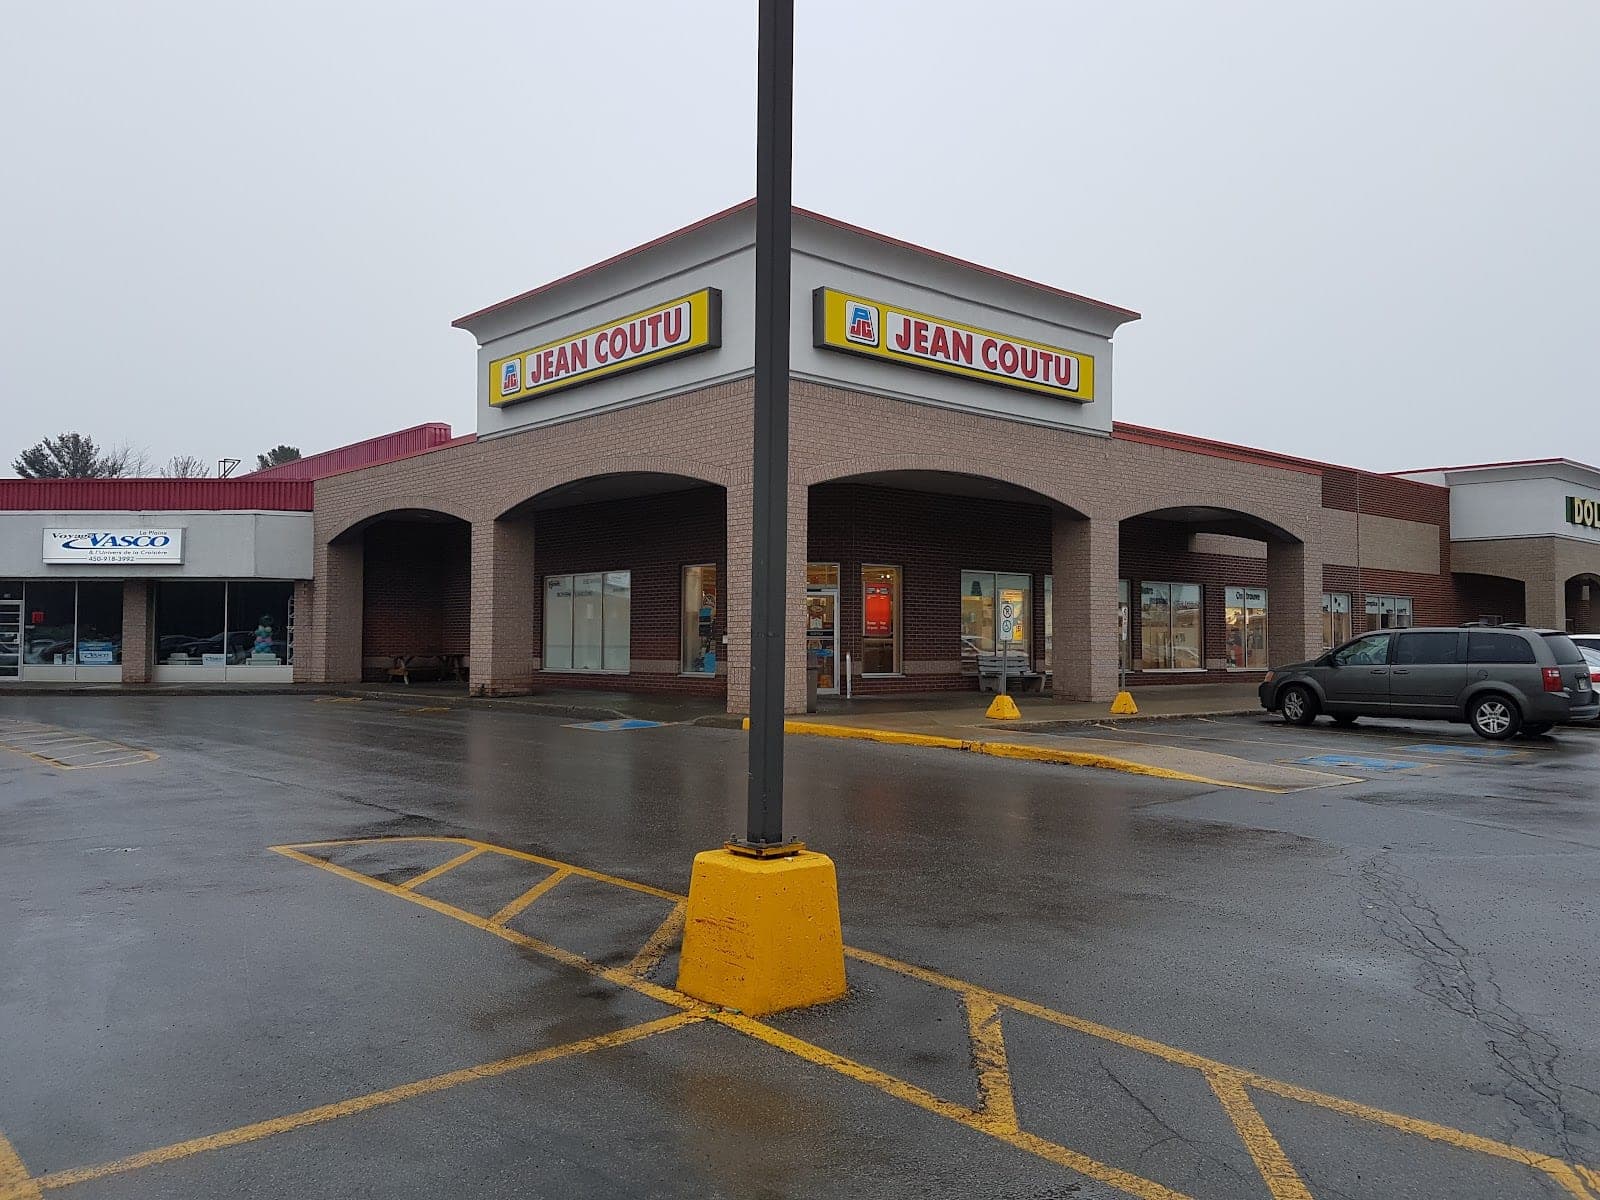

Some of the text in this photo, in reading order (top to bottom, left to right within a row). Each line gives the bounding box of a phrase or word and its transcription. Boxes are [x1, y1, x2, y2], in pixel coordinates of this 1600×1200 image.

[531, 307, 682, 384] JEAN COUTU
[895, 317, 1071, 386] JEAN COUTU
[88, 532, 170, 548] VASCO
